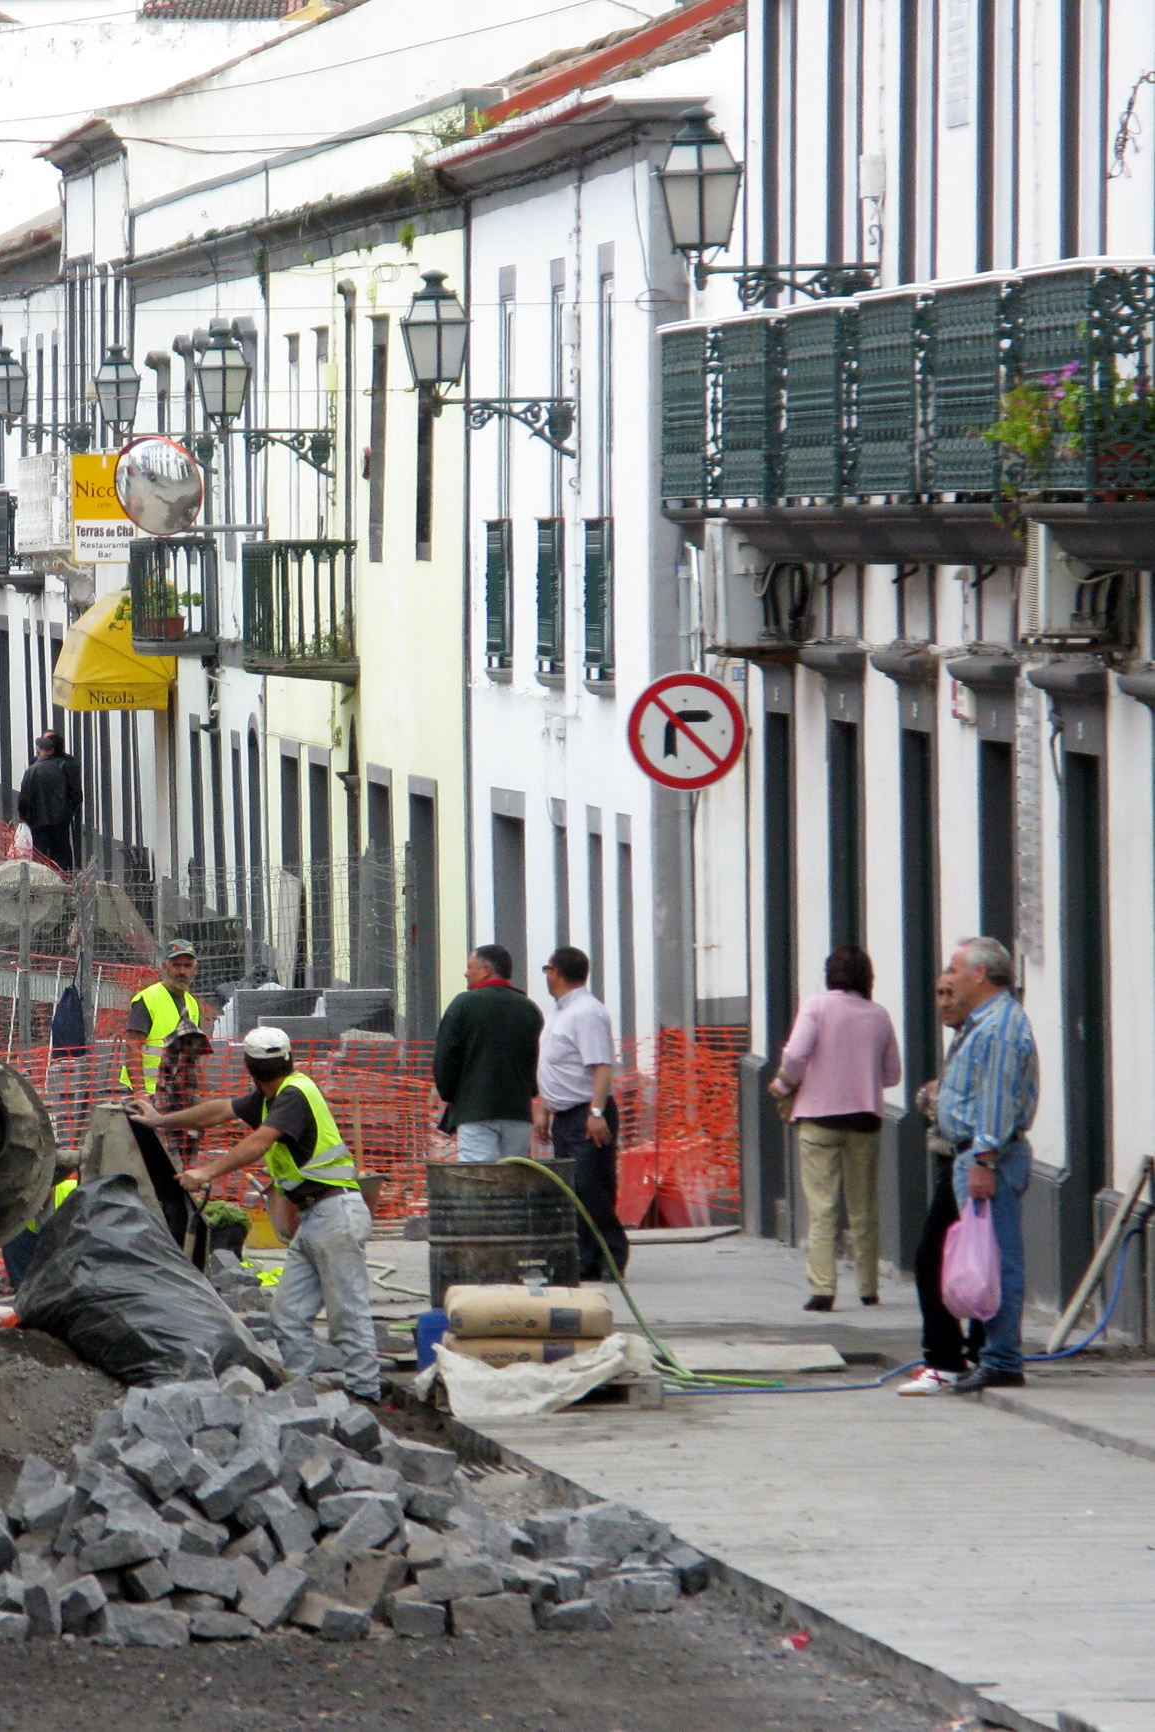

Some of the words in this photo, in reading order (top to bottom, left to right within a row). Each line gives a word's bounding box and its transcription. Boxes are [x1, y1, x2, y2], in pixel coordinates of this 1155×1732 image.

[75, 480, 117, 498] Nico
[76, 526, 104, 537] Terras
[106, 527, 115, 537] de
[117, 524, 134, 537] Chá
[80, 541, 129, 549] Restaurante
[98, 550, 112, 558] Bar
[89, 690, 134, 704] Nicola
